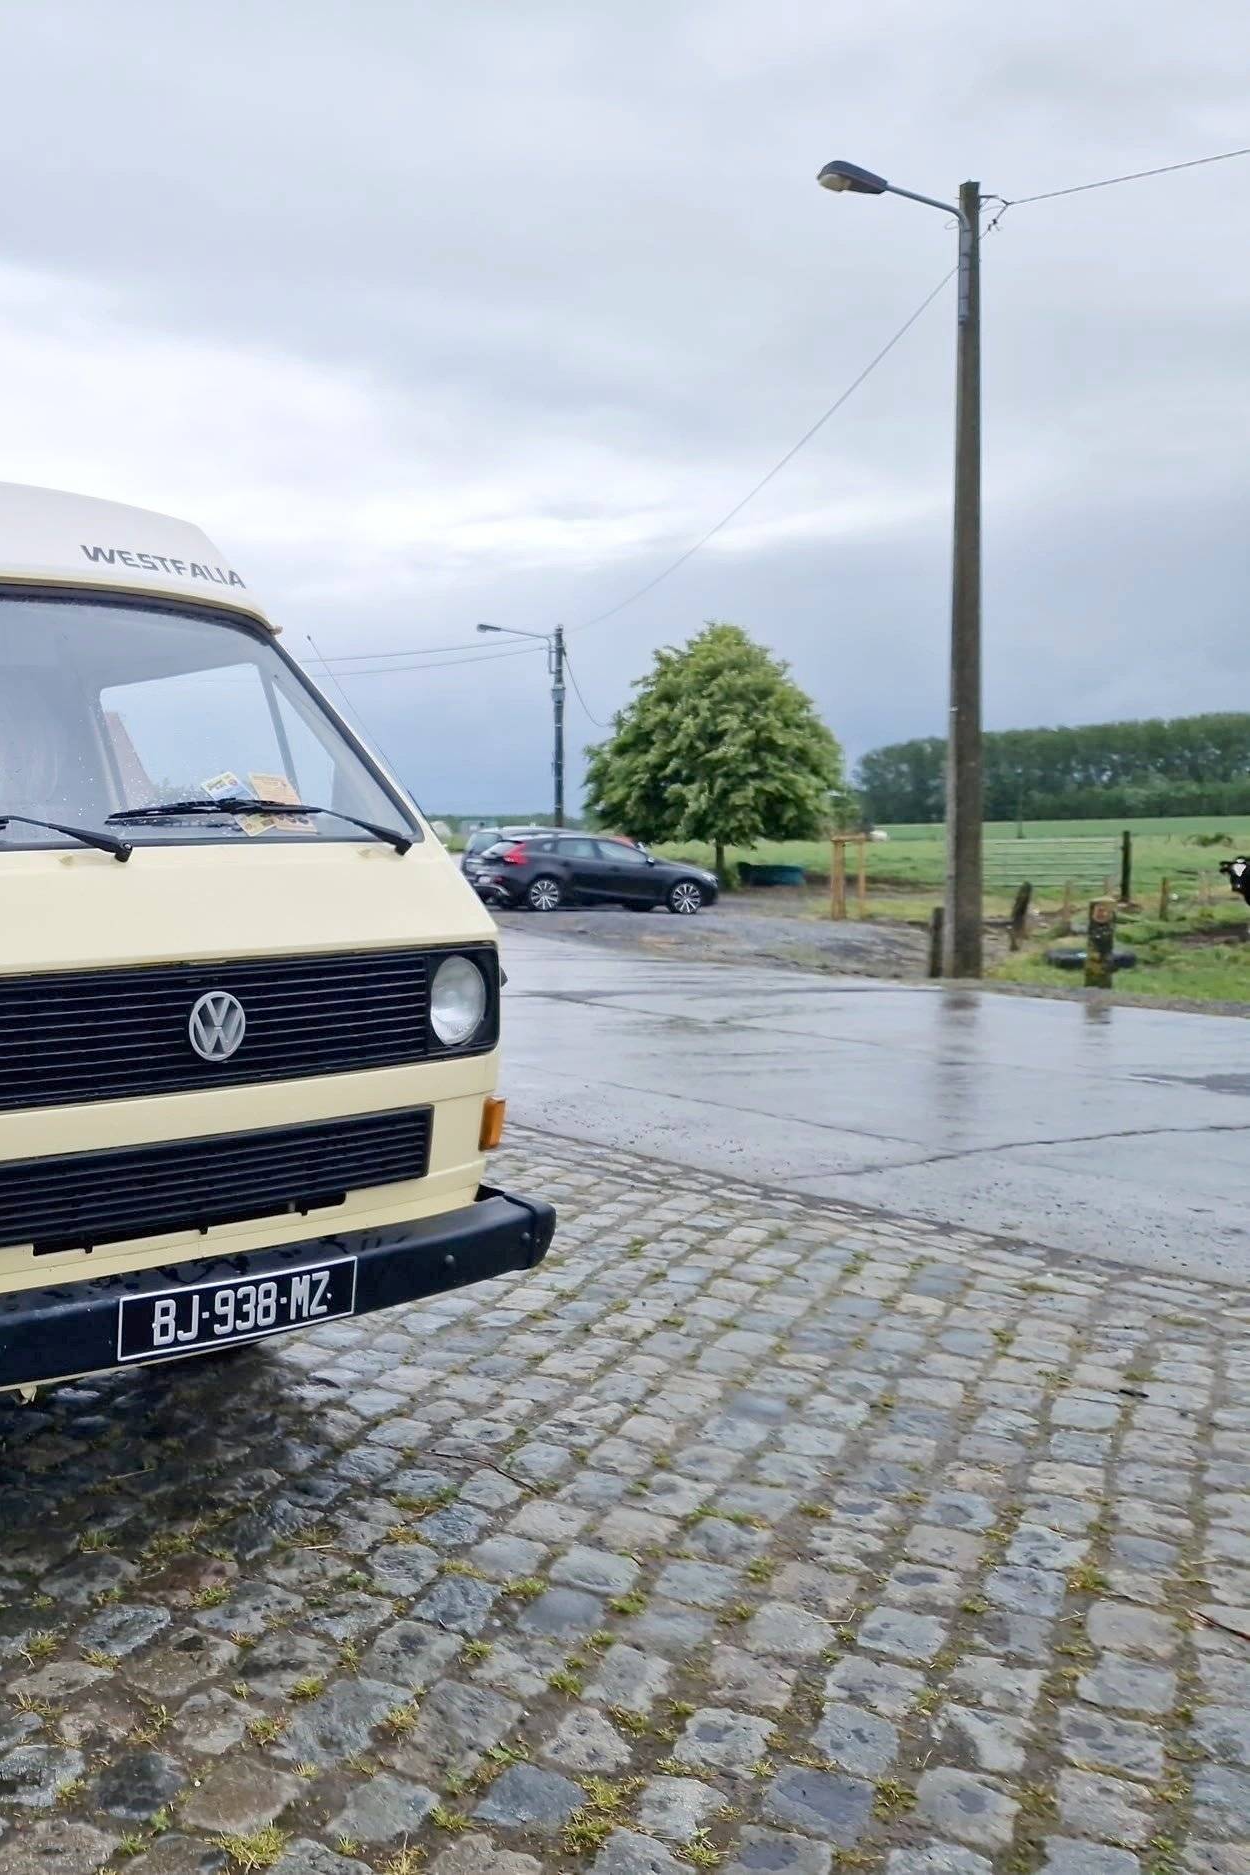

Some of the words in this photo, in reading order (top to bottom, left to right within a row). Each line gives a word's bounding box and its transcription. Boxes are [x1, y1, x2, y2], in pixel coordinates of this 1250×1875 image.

[79, 544, 247, 589] WESTFALIA
[190, 992, 244, 1059] VW
[153, 1270, 331, 1346] BJ-938-MZ
